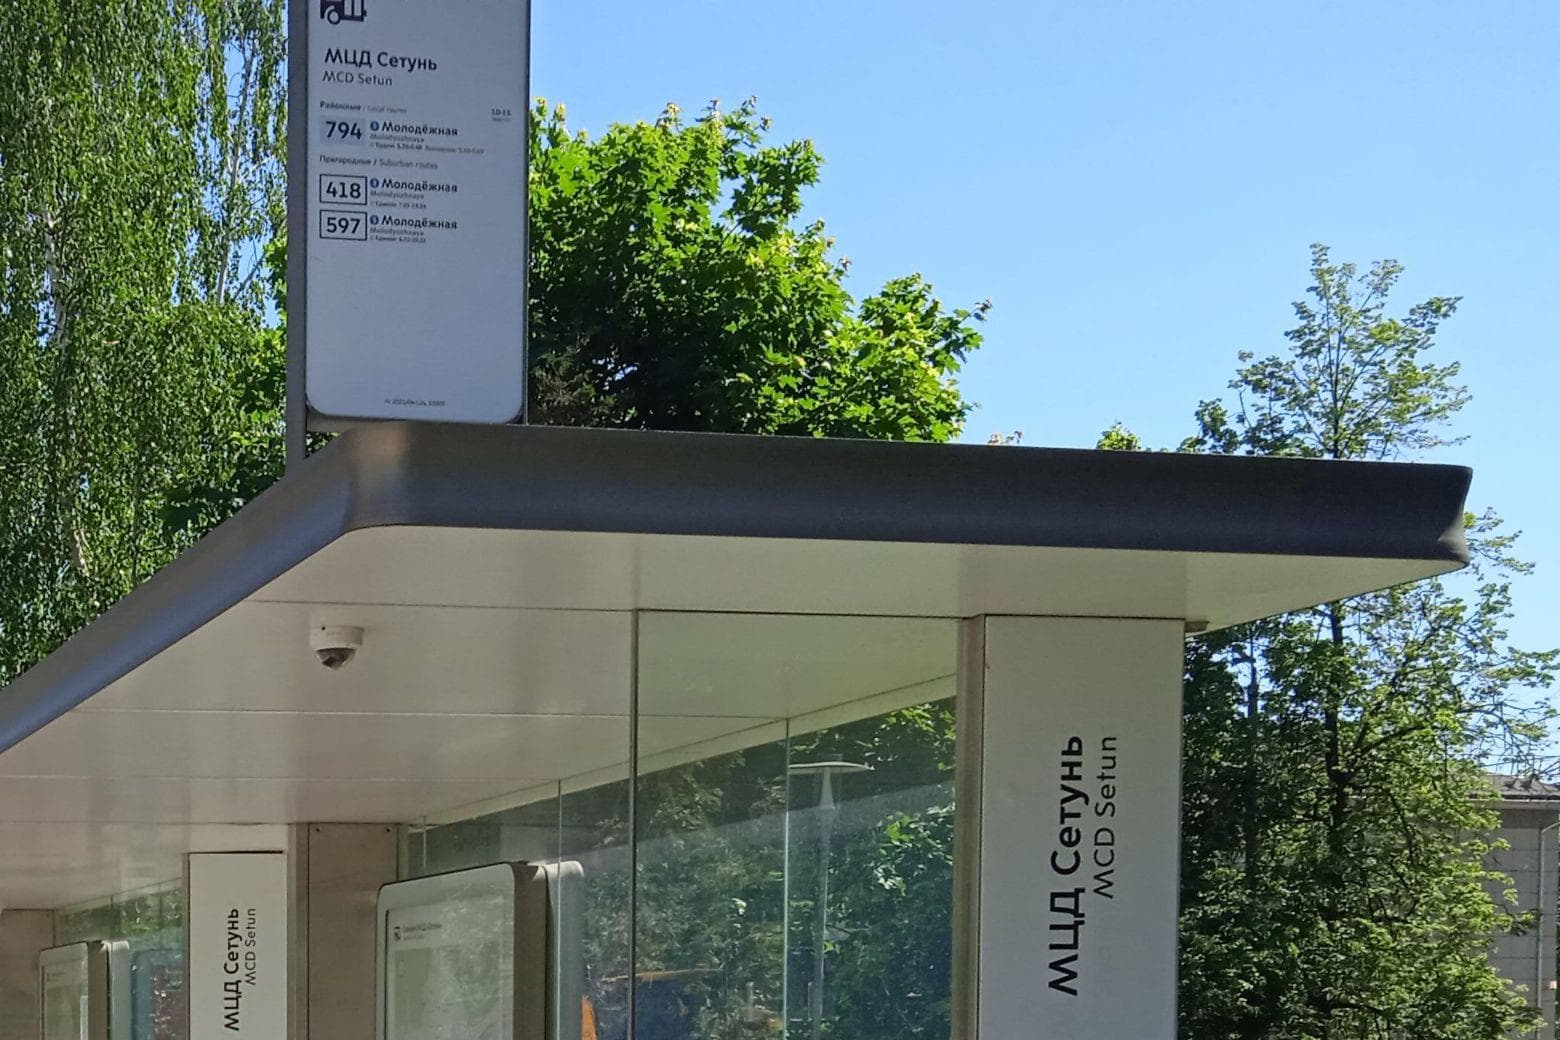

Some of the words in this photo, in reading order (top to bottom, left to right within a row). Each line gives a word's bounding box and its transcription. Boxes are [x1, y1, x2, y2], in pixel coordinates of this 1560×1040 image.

[322, 70, 354, 84] MCD
[357, 72, 393, 86] Setun
[324, 48, 372, 68] МЦД
[377, 52, 438, 73] Сетунь
[326, 120, 362, 141] 794
[382, 120, 458, 136] Молодёжная
[326, 181, 361, 199] 418
[382, 178, 458, 193] Молодёжная
[326, 216, 361, 234] 597
[382, 215, 457, 229] Молодёжная
[1095, 737, 1117, 817] Setun
[1050, 736, 1089, 875] Сетунь
[1093, 828, 1115, 899] MCD
[224, 908, 242, 974] Сетунь
[245, 908, 256, 947] Setun
[1048, 888, 1085, 996] МЦД
[245, 951, 256, 985] MCD
[223, 980, 242, 1031] МЦД
